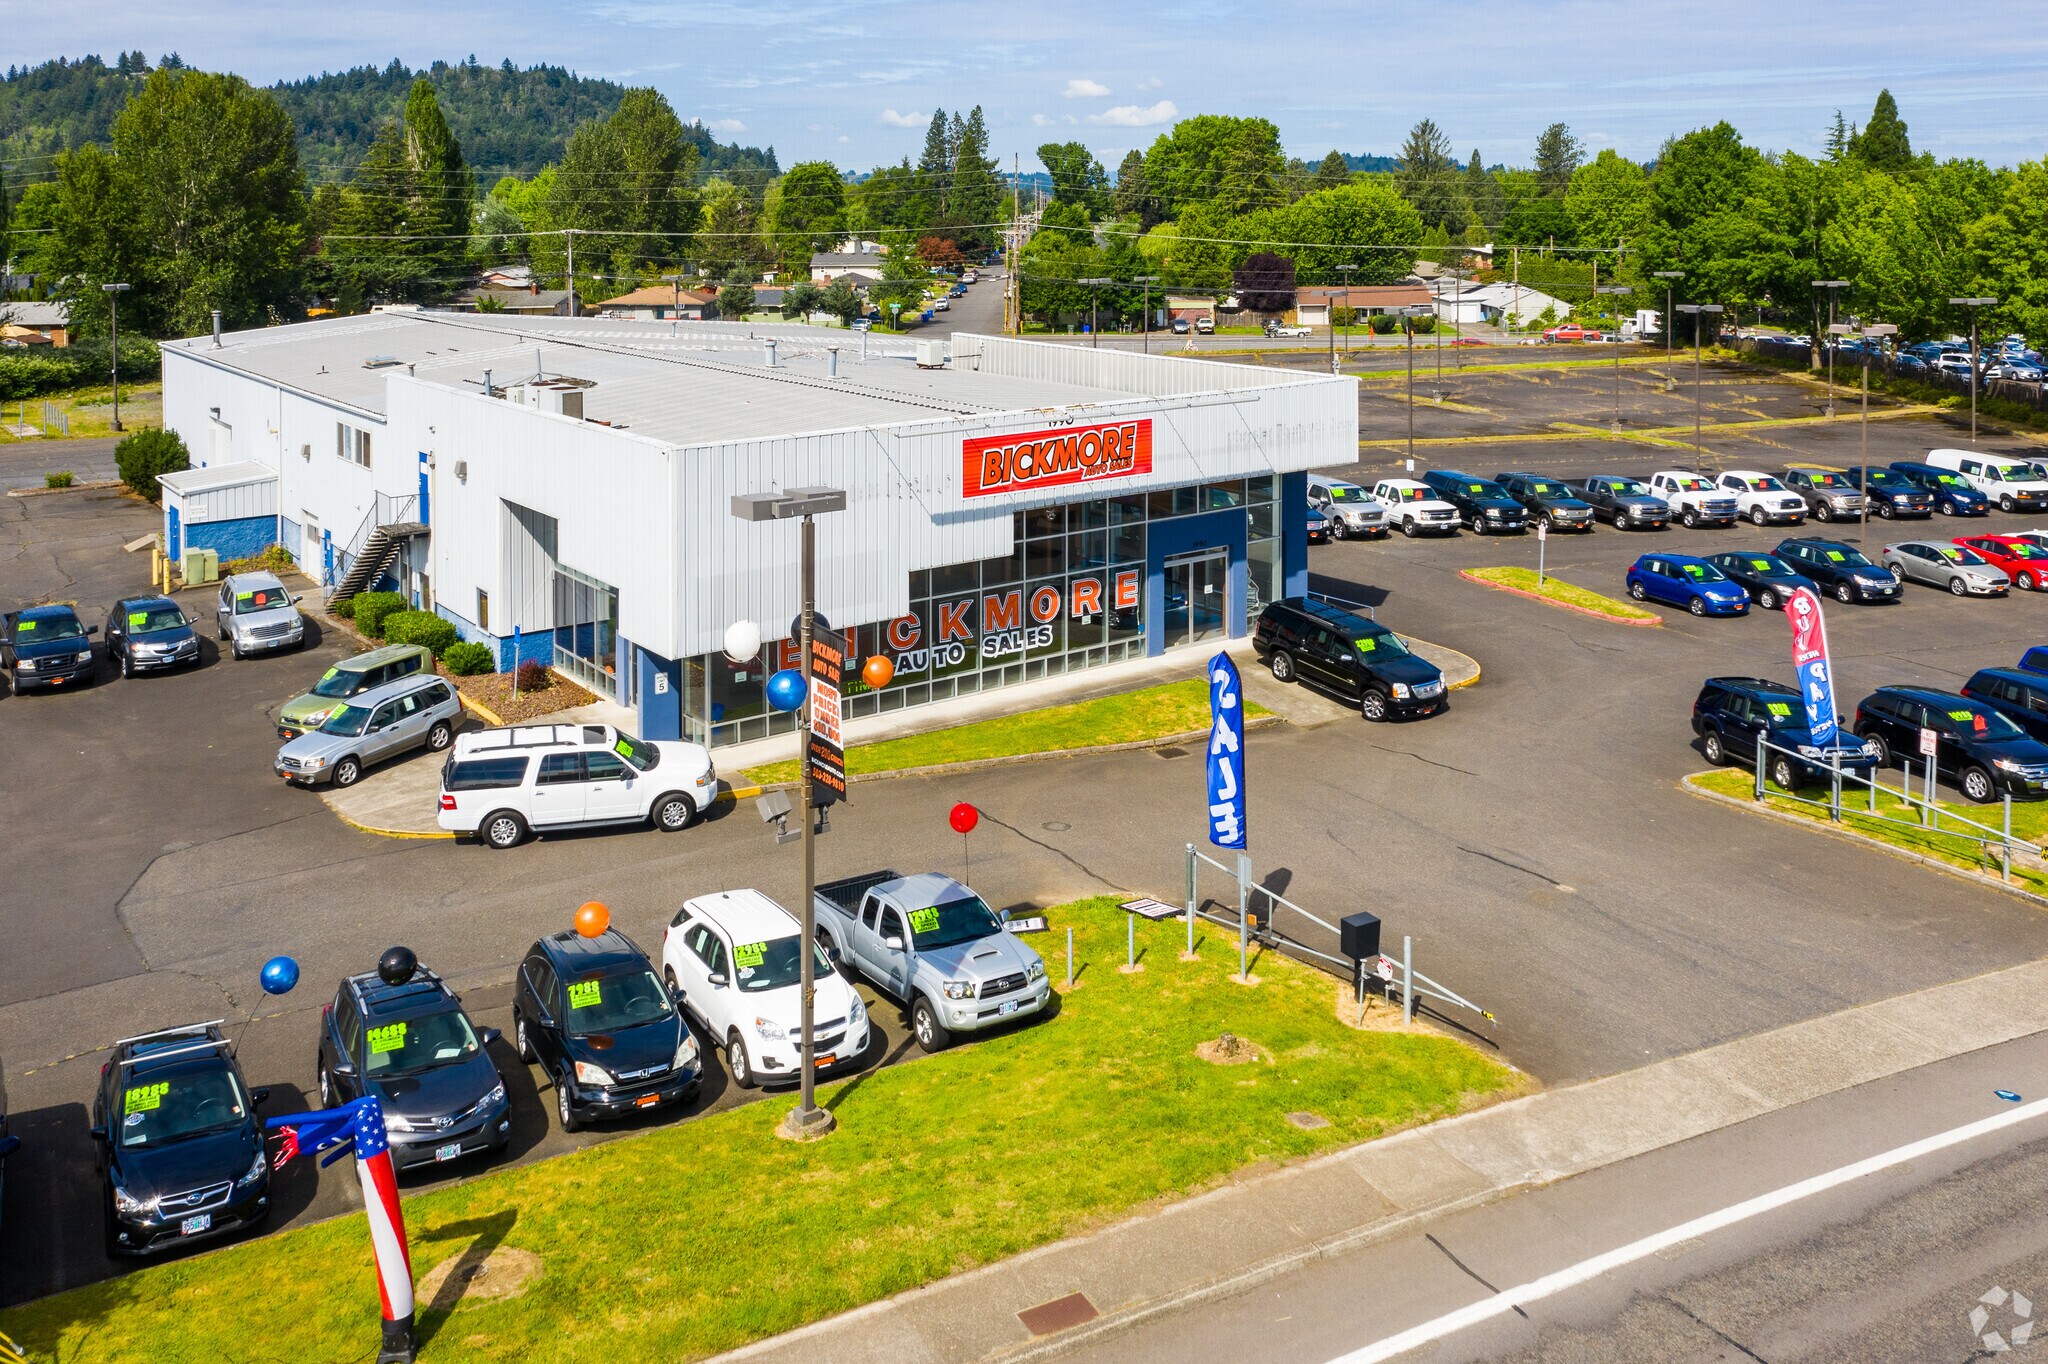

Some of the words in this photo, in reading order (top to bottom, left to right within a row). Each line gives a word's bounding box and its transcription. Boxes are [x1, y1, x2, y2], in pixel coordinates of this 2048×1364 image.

[982, 424, 1136, 487] BICKMORE
[1084, 463, 1108, 478] AUTO
[1109, 457, 1133, 472] SALES
[812, 640, 843, 667] BICKMORE
[893, 641, 966, 677] AUTO
[982, 625, 1054, 659] SALES
[812, 658, 828, 675] AUTO
[659, 682, 665, 691] 5
[817, 682, 838, 702] MOST
[568, 980, 600, 997] 7988
[366, 1022, 407, 1042] 14688
[125, 1082, 170, 1102] 18988
